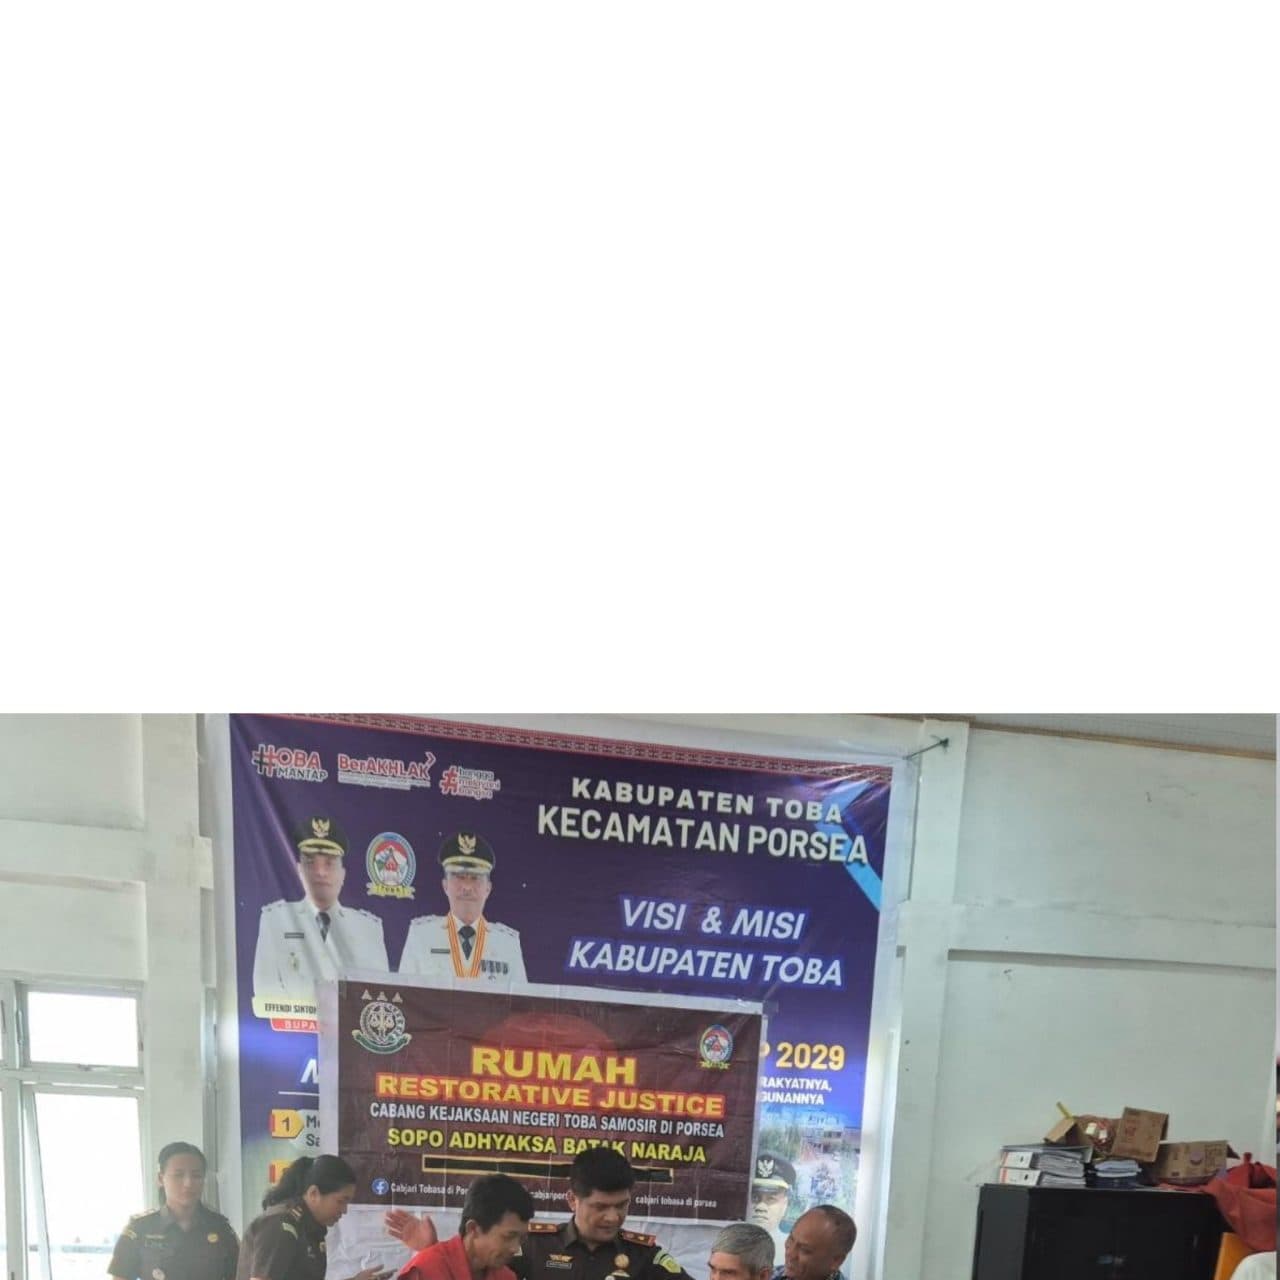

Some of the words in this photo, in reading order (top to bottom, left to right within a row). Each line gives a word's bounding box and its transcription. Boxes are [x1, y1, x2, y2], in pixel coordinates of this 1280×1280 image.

[277, 767, 328, 782] MANTAP
[339, 754, 430, 780] BerAKHLAK
[572, 777, 753, 815] KABUPATEN
[767, 797, 843, 824] TOBA
[538, 804, 740, 852] KECAMATAN
[748, 825, 868, 865] PORSEA
[622, 899, 687, 931] VISI
[701, 906, 722, 934] &
[731, 908, 806, 940] MISI
[568, 941, 753, 980] KABUPATEN
[762, 955, 843, 986] TOBA
[472, 1046, 636, 1085] RUMAH
[775, 1042, 845, 1070] 2029
[378, 1075, 591, 1106] RESTORATIVE
[599, 1088, 723, 1116] JUSTICE
[370, 1103, 425, 1119] CABANG
[430, 1106, 509, 1123] KEJAKSAAN
[513, 1110, 559, 1127] NEGERI
[565, 1115, 597, 1129] TOBA
[601, 1117, 657, 1134] SAMOSIR
[660, 1121, 673, 1134] DI
[676, 1123, 724, 1138] PORSEA
[388, 1128, 443, 1147] SOPO
[450, 1131, 557, 1153] ADHYAKSA
[632, 1142, 706, 1163] NARAJA
